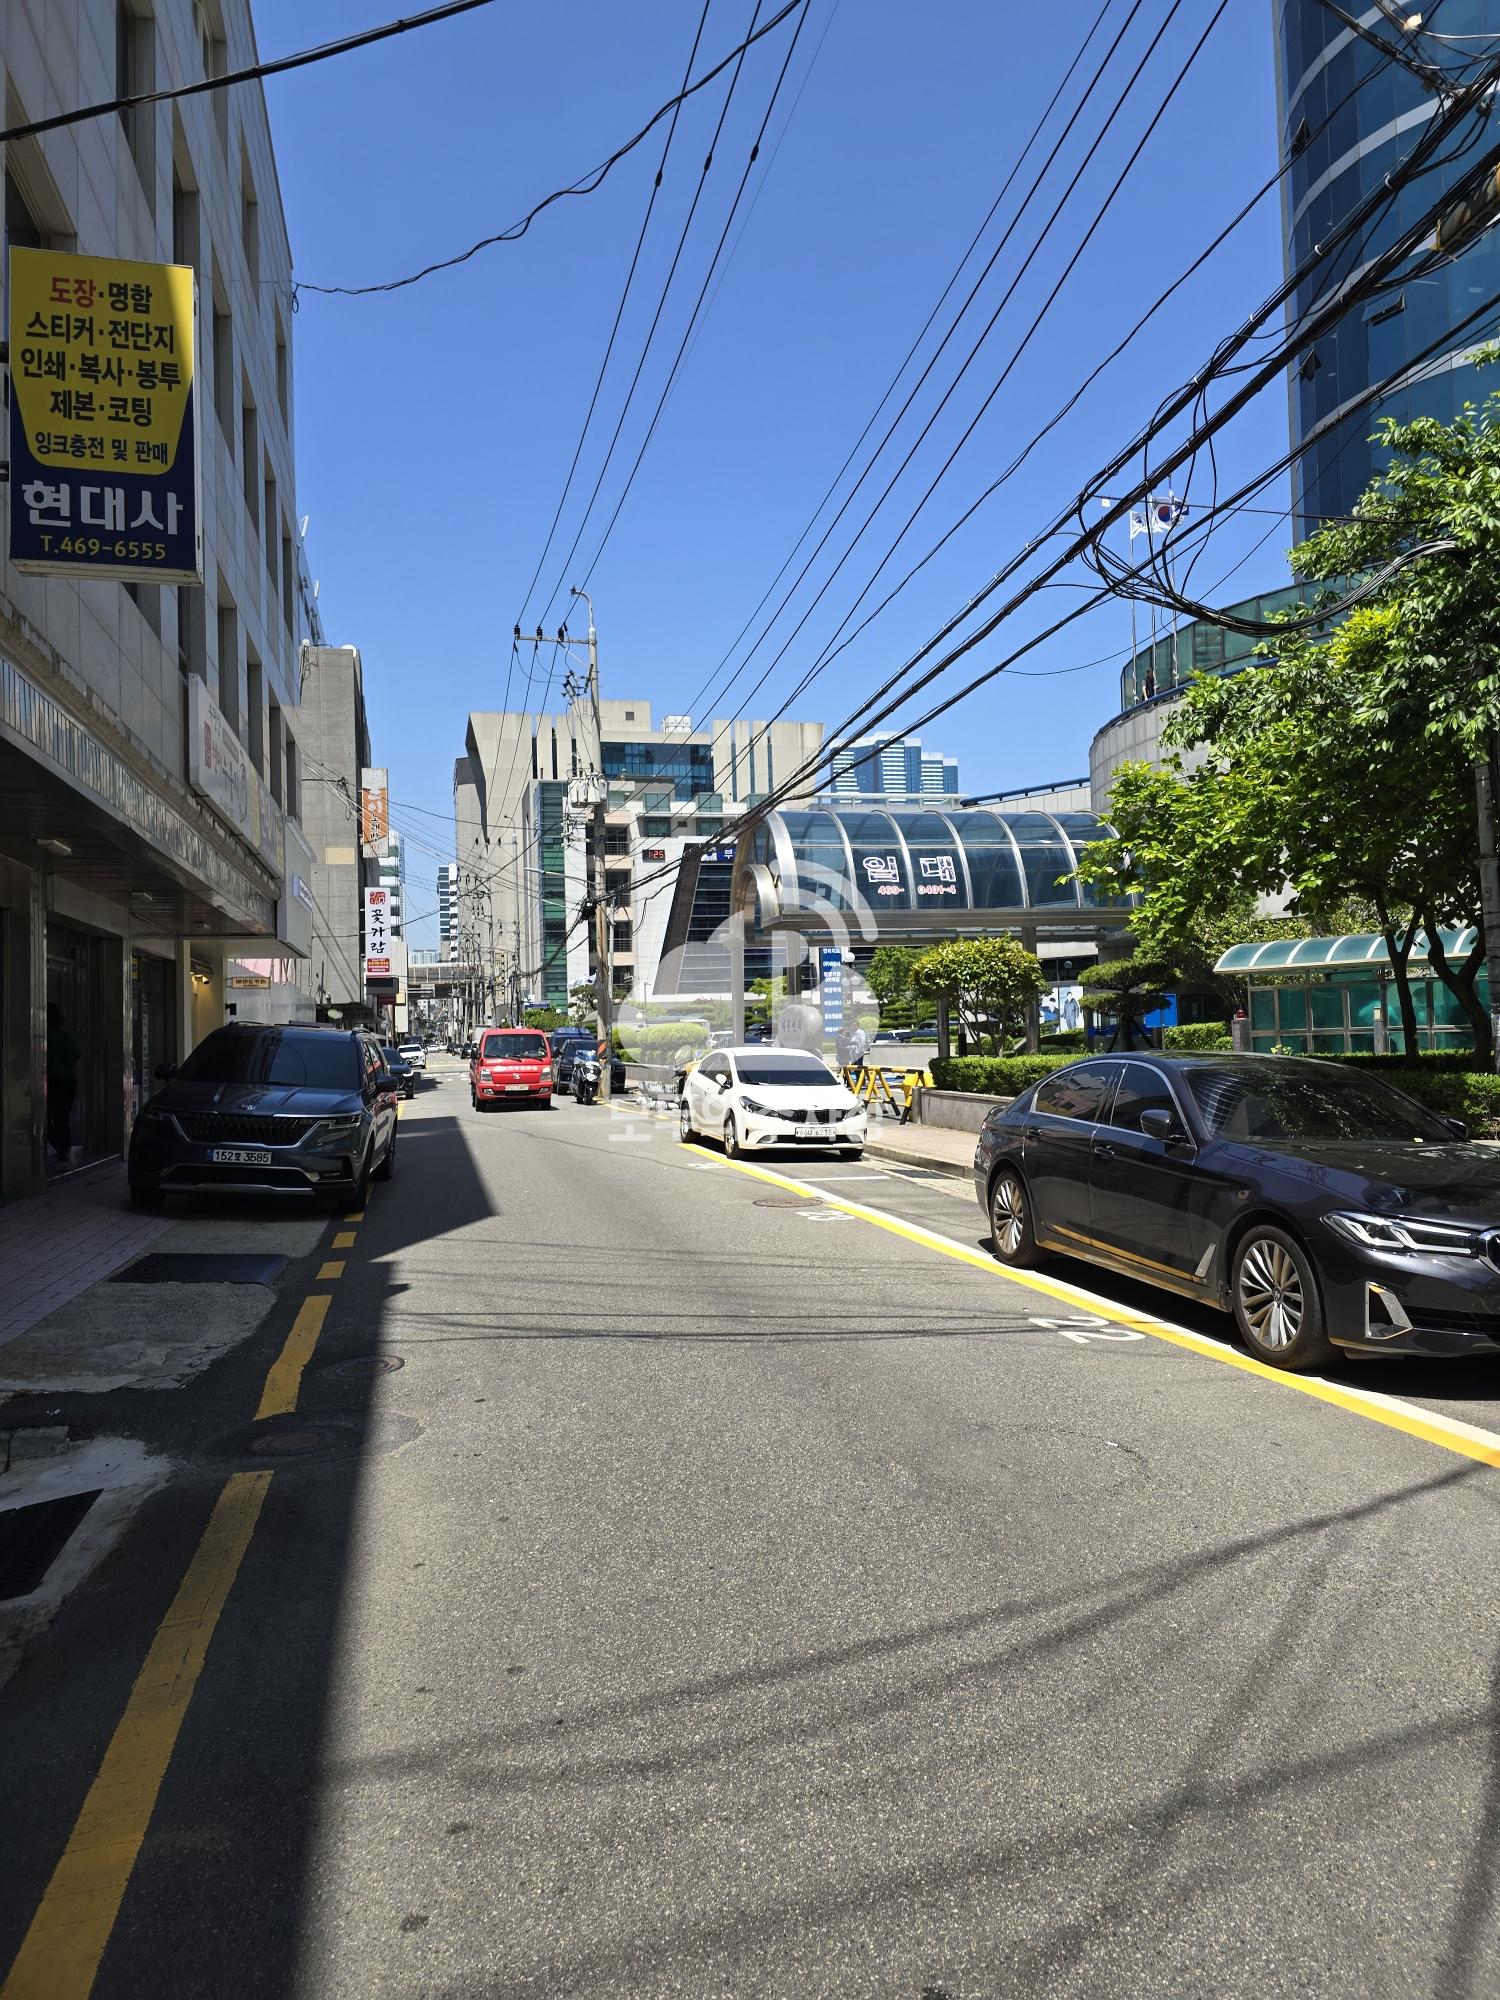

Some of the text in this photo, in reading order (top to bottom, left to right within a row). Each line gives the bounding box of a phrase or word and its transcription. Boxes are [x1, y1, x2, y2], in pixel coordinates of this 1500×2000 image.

[49, 276, 153, 315] 도장·명함
[25, 311, 175, 355] 스티커·전단지
[20, 347, 182, 393] 인쇄·복사·봉투
[49, 390, 153, 428] 제본·코팅
[35, 431, 169, 466] 잉크충전 및 판매
[21, 479, 184, 536] 현대사
[40, 534, 167, 560] T.469-6555
[369, 813, 381, 841] 노래방
[243, 1152, 269, 1163] 3585
